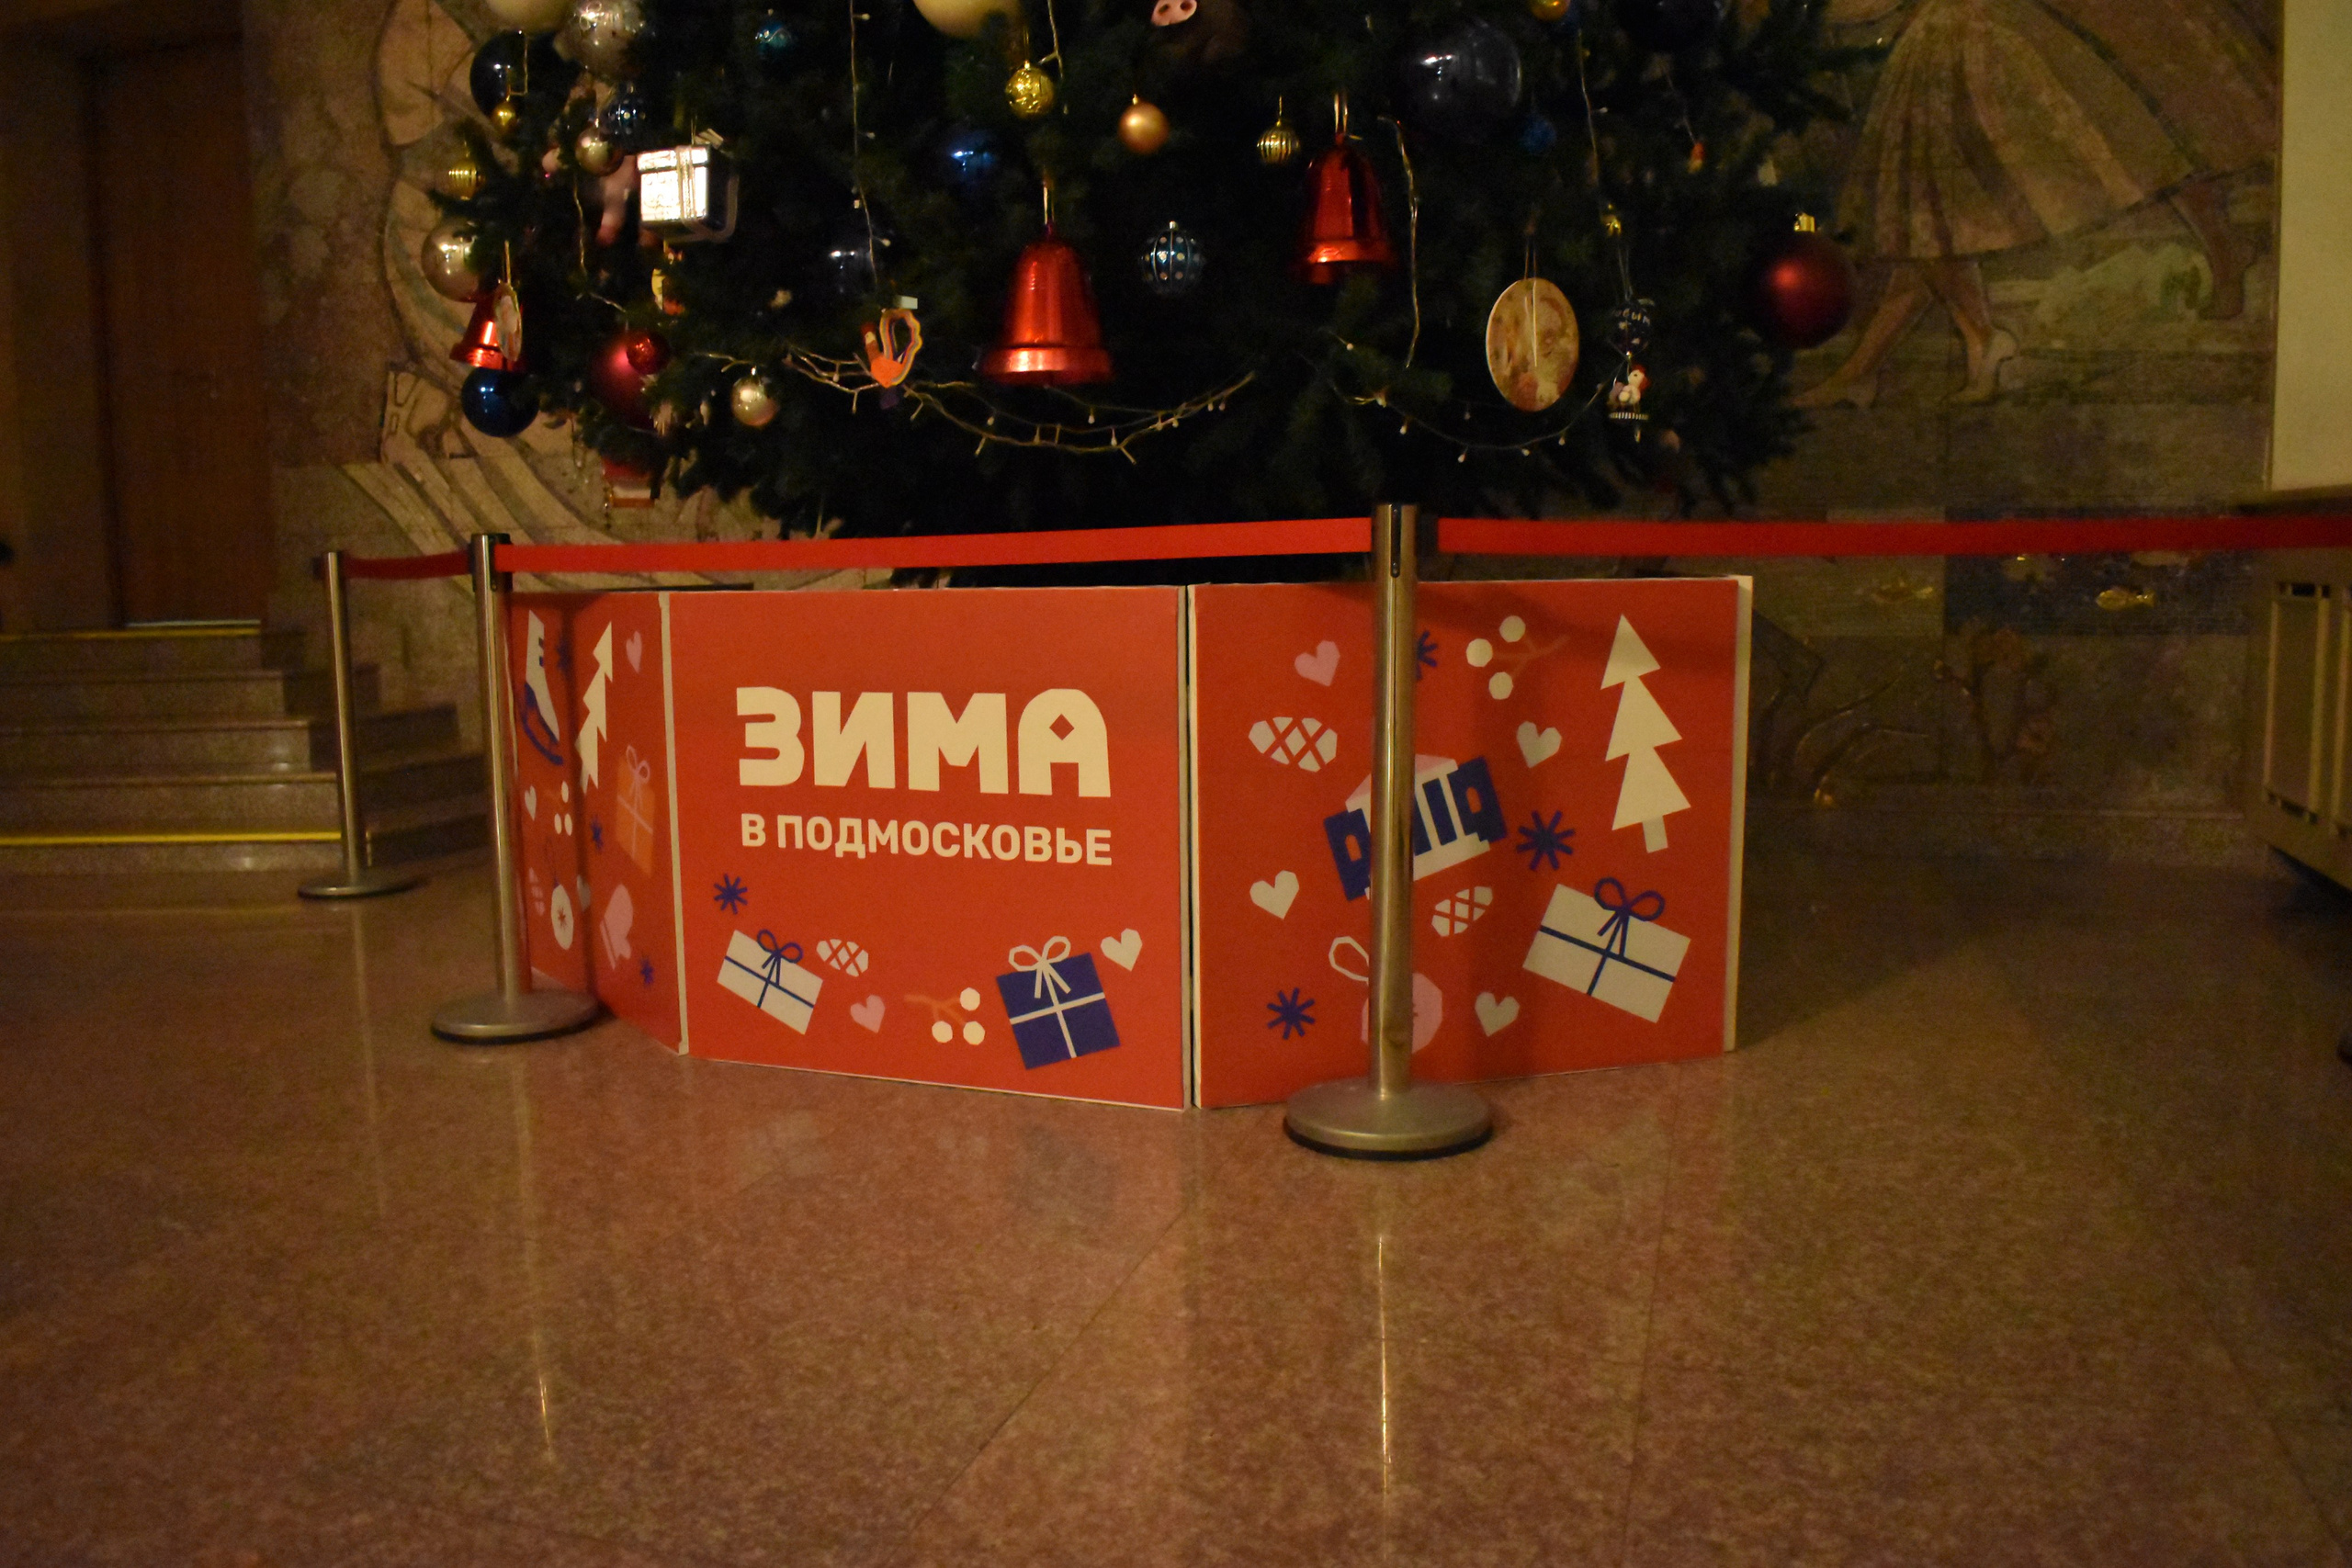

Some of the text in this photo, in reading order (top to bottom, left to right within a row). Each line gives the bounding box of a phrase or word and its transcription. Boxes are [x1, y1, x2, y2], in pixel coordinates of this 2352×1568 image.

[736, 686, 1111, 797] ЗИМА
[741, 813, 1113, 865] В ПОДМОСКОВЬЕ
